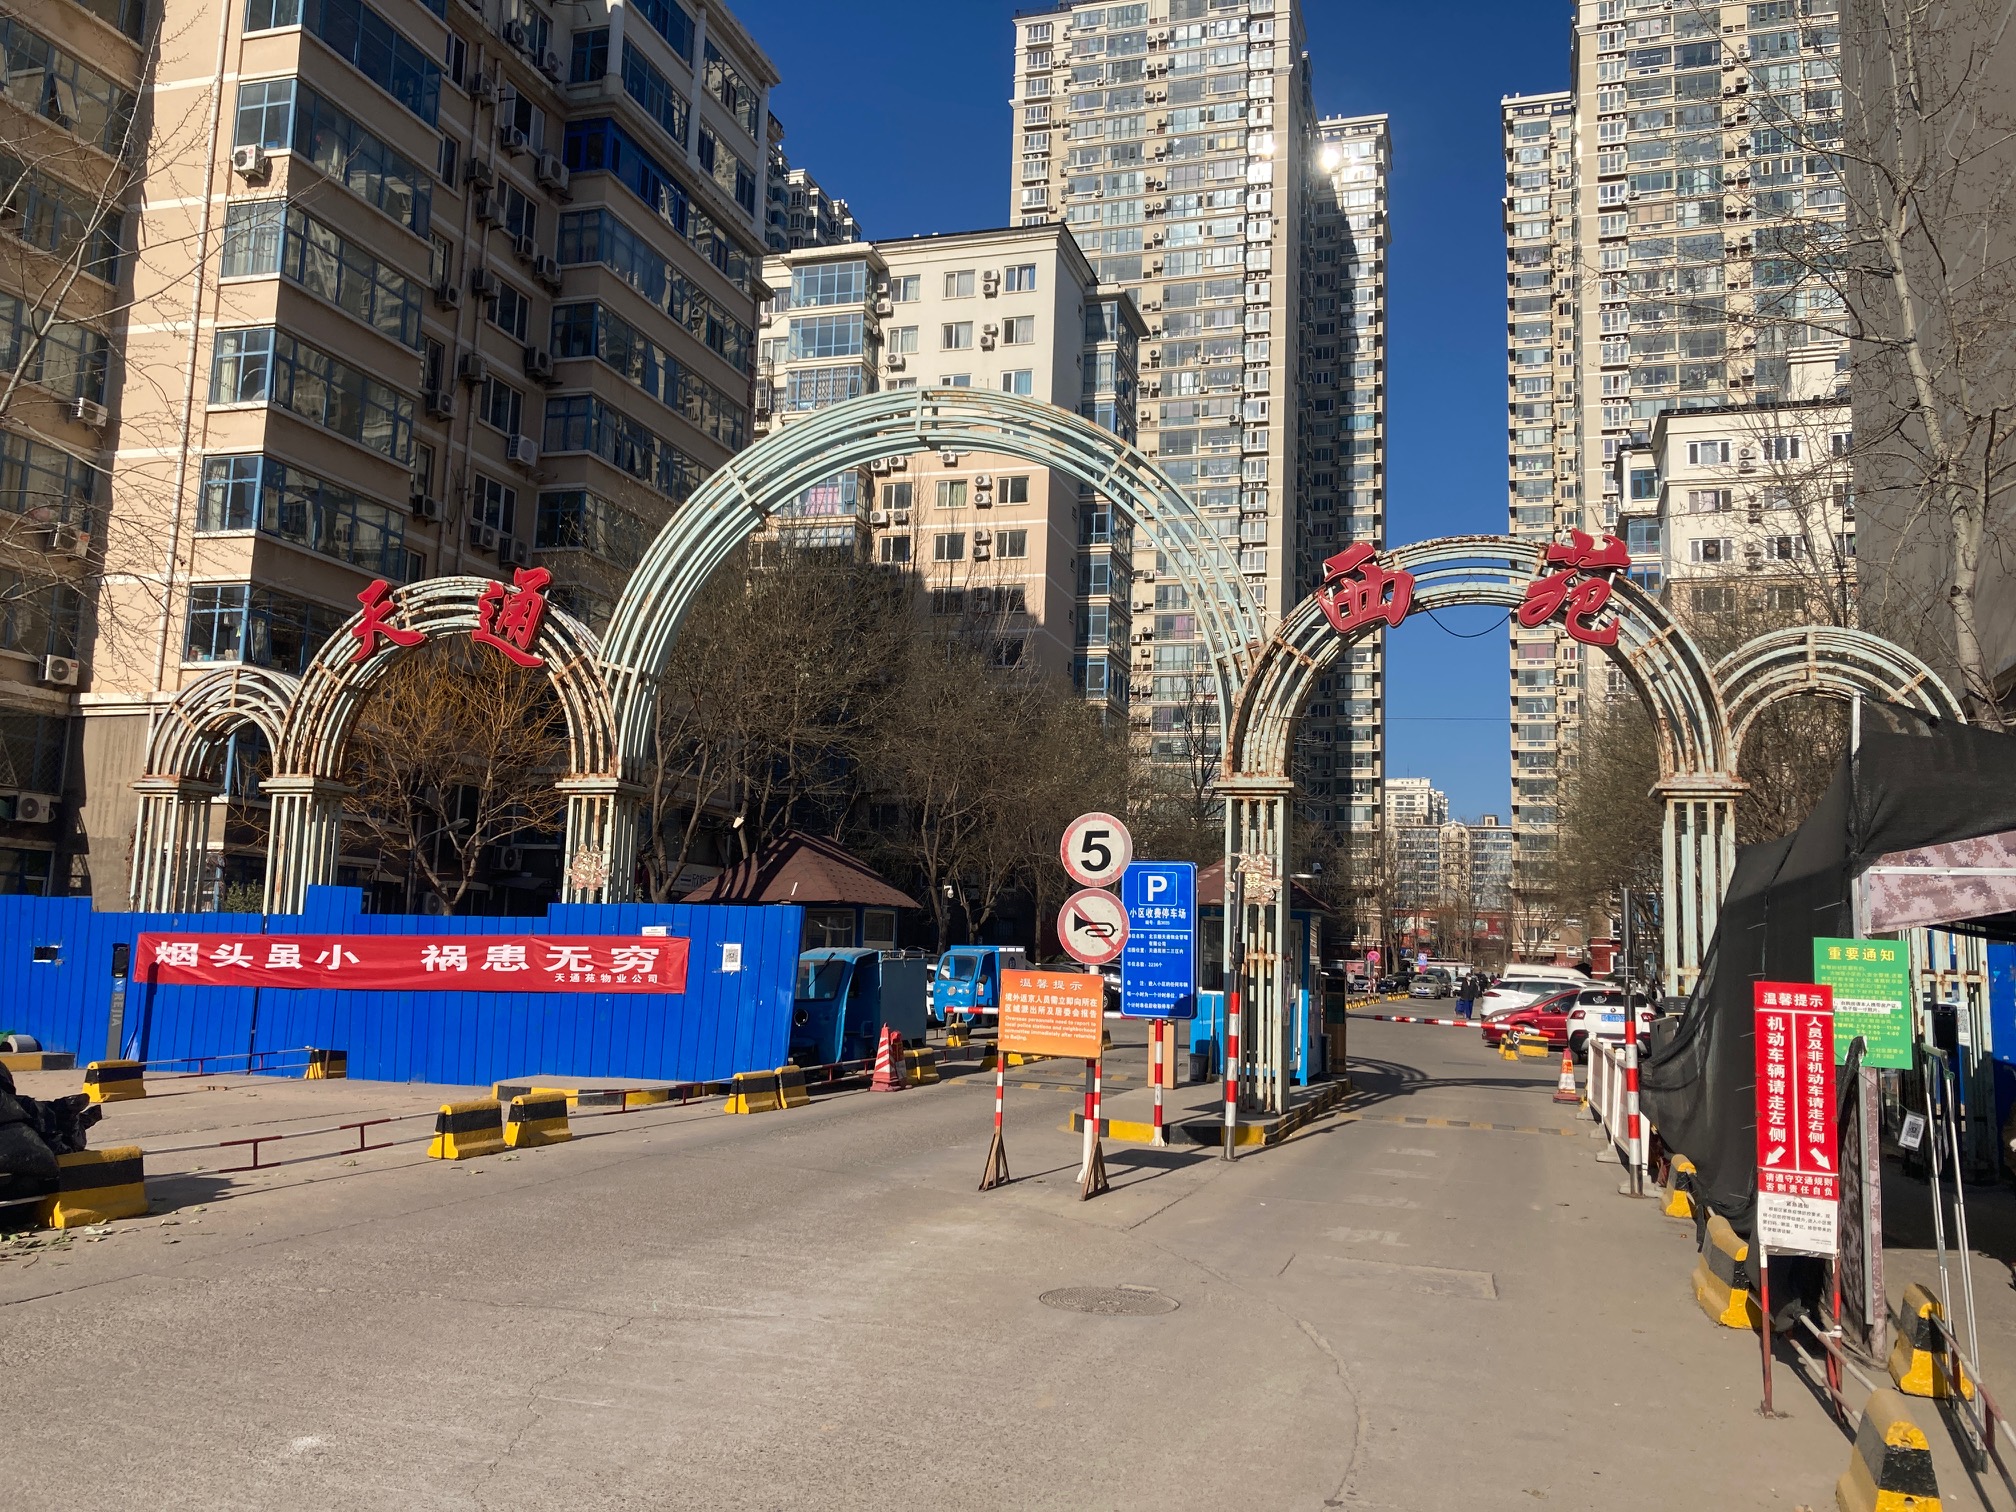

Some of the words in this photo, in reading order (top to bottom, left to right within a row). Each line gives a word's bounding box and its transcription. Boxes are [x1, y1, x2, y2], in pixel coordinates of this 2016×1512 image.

[349, 566, 553, 668] 天通
[1081, 830, 1112, 872] 5
[1147, 875, 1168, 902] P
[1129, 907, 1187, 919] 小区收费停车场
[155, 941, 360, 970] 烟头虽小
[420, 944, 660, 973] 祸患无穷
[1828, 946, 1894, 962] 重要通知
[554, 973, 658, 984] 天通苑物业公司
[1020, 978, 1083, 991] 温馨提示
[1005, 992, 1098, 1007] 境外返京人员需立即向所在
[1763, 992, 1823, 1008] 温馨提示
[1005, 1003, 1097, 1018] 区域派出所及居委会报告
[1766, 1016, 1786, 1143] 机动车辆请走左侧
[1807, 1016, 1825, 1144] 人员及非机动车请走右侧
[1765, 1173, 1833, 1187] 请遵守交通规则
[1766, 1182, 1833, 1197] 否则责任自负
